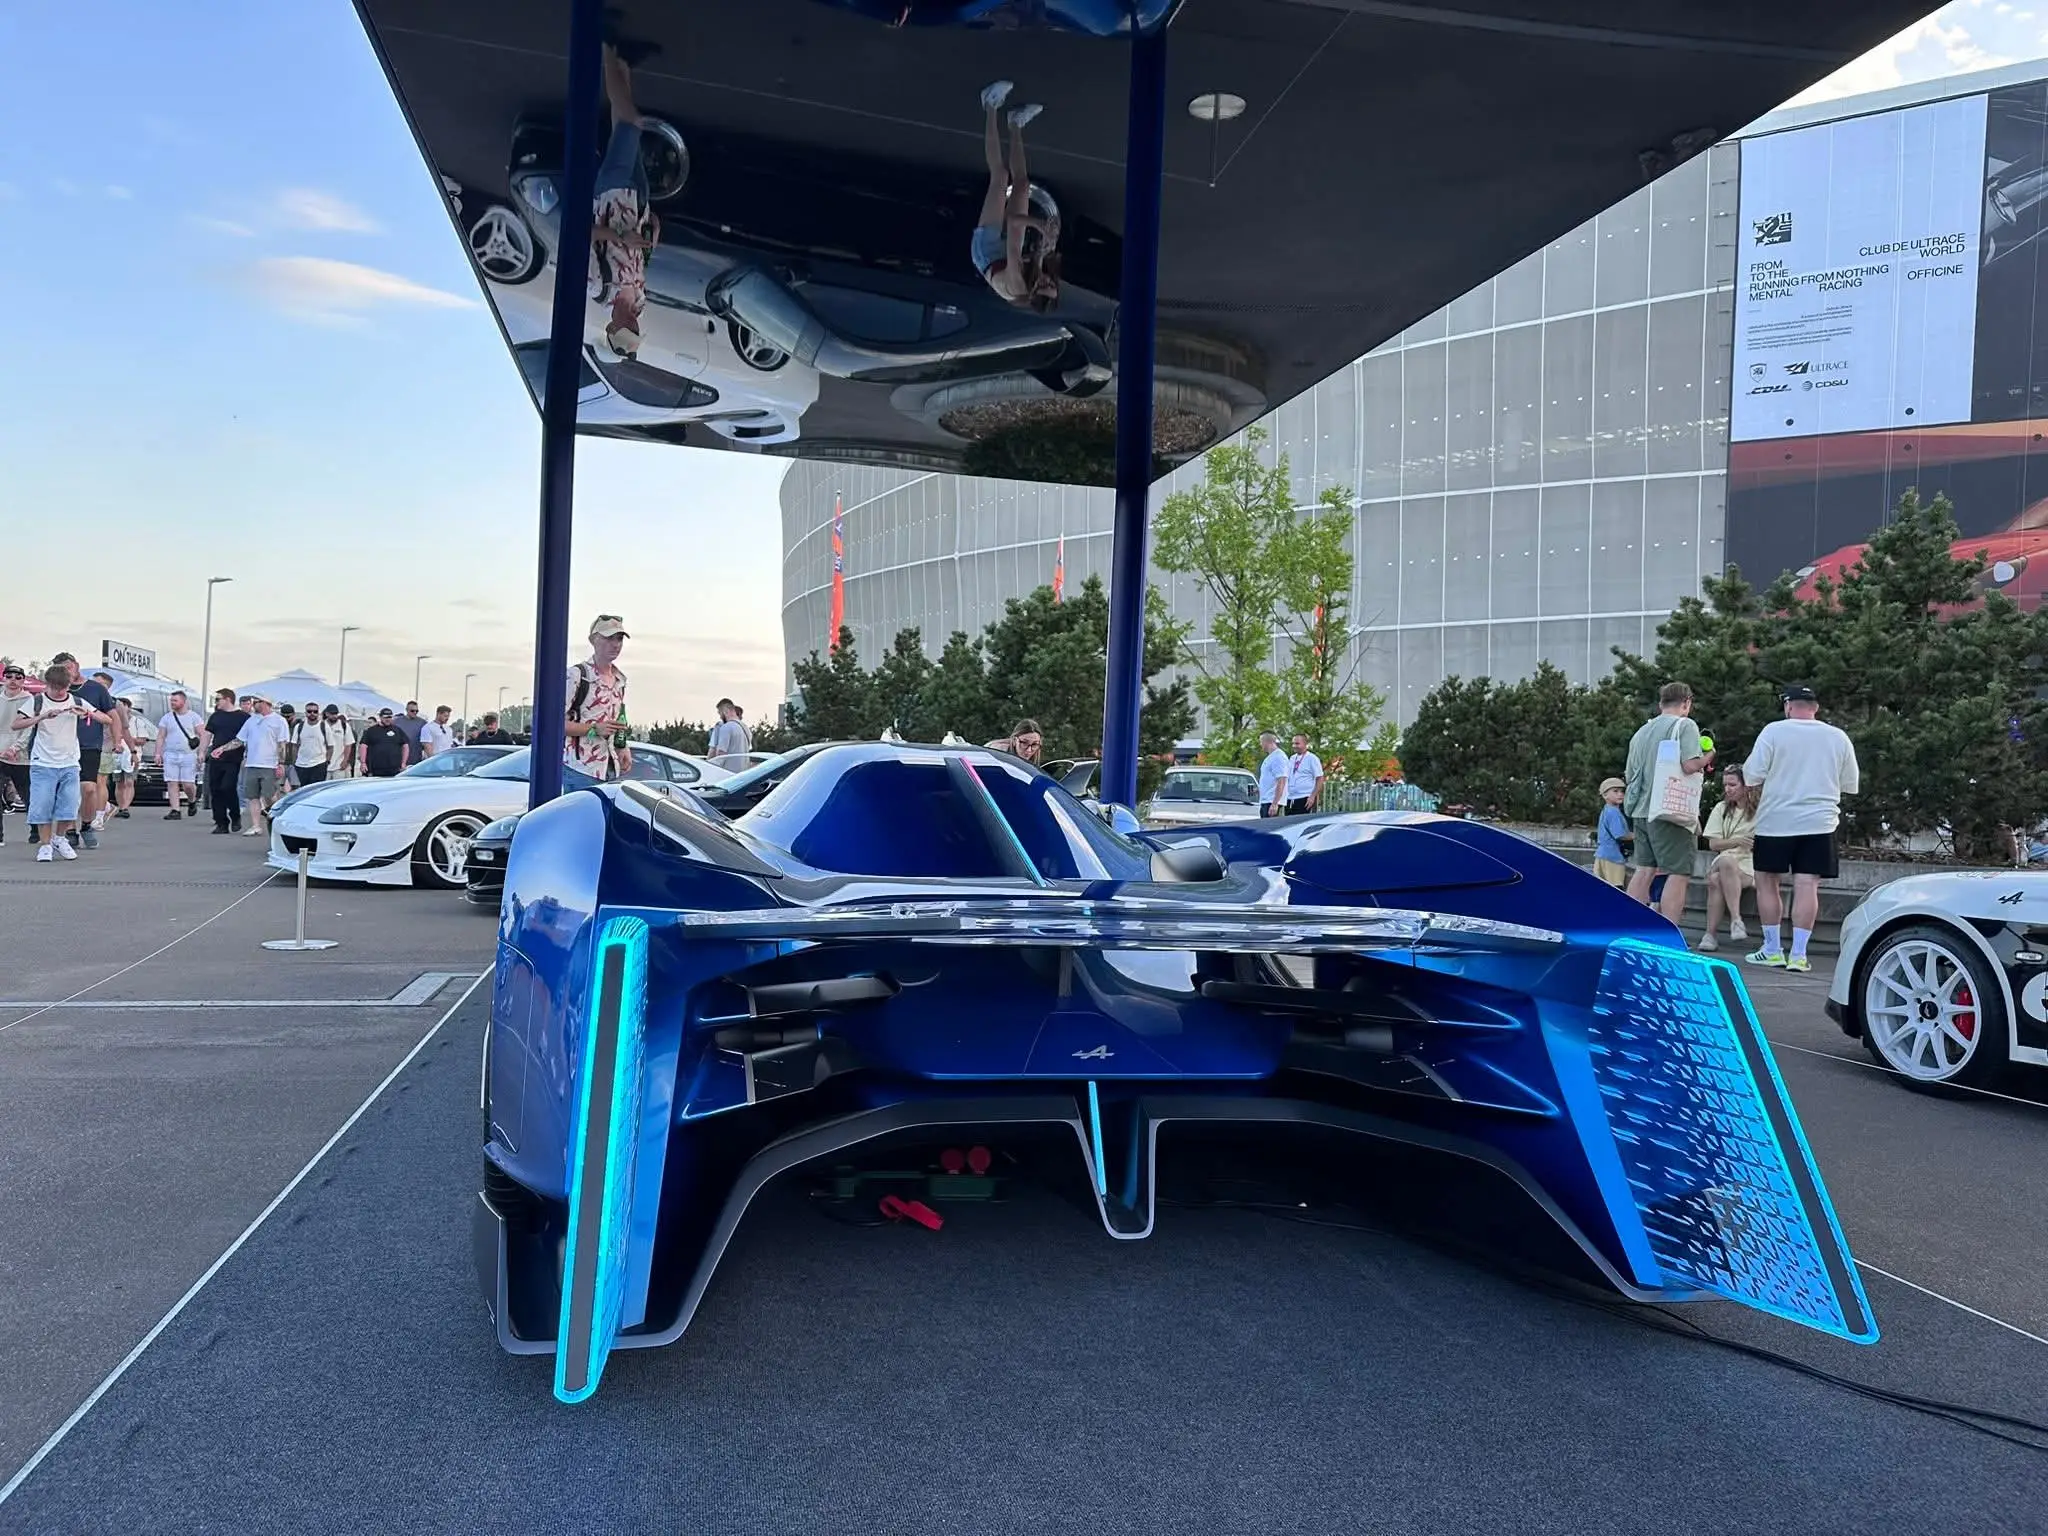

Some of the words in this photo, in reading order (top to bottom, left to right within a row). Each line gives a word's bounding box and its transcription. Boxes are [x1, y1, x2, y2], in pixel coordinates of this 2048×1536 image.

[1859, 244, 1891, 257] CLUB
[1892, 242, 1909, 252] DE
[1910, 233, 1965, 249] ULTRACE
[1920, 244, 1965, 258] WORLD
[1750, 260, 1783, 272] FROM
[1907, 265, 1963, 280] OFFICINE
[1750, 277, 1800, 292] RUNNING
[1801, 272, 1834, 284] FROM
[1836, 265, 1889, 279] NOTHING
[1751, 272, 1765, 281] TO
[1767, 269, 1789, 278] THE
[1819, 278, 1862, 292] RACING
[1749, 289, 1793, 301] MENTAL
[1811, 361, 1848, 372] ULTRACE
[126, 652, 137, 666] THE
[138, 654, 150, 670] BAR
